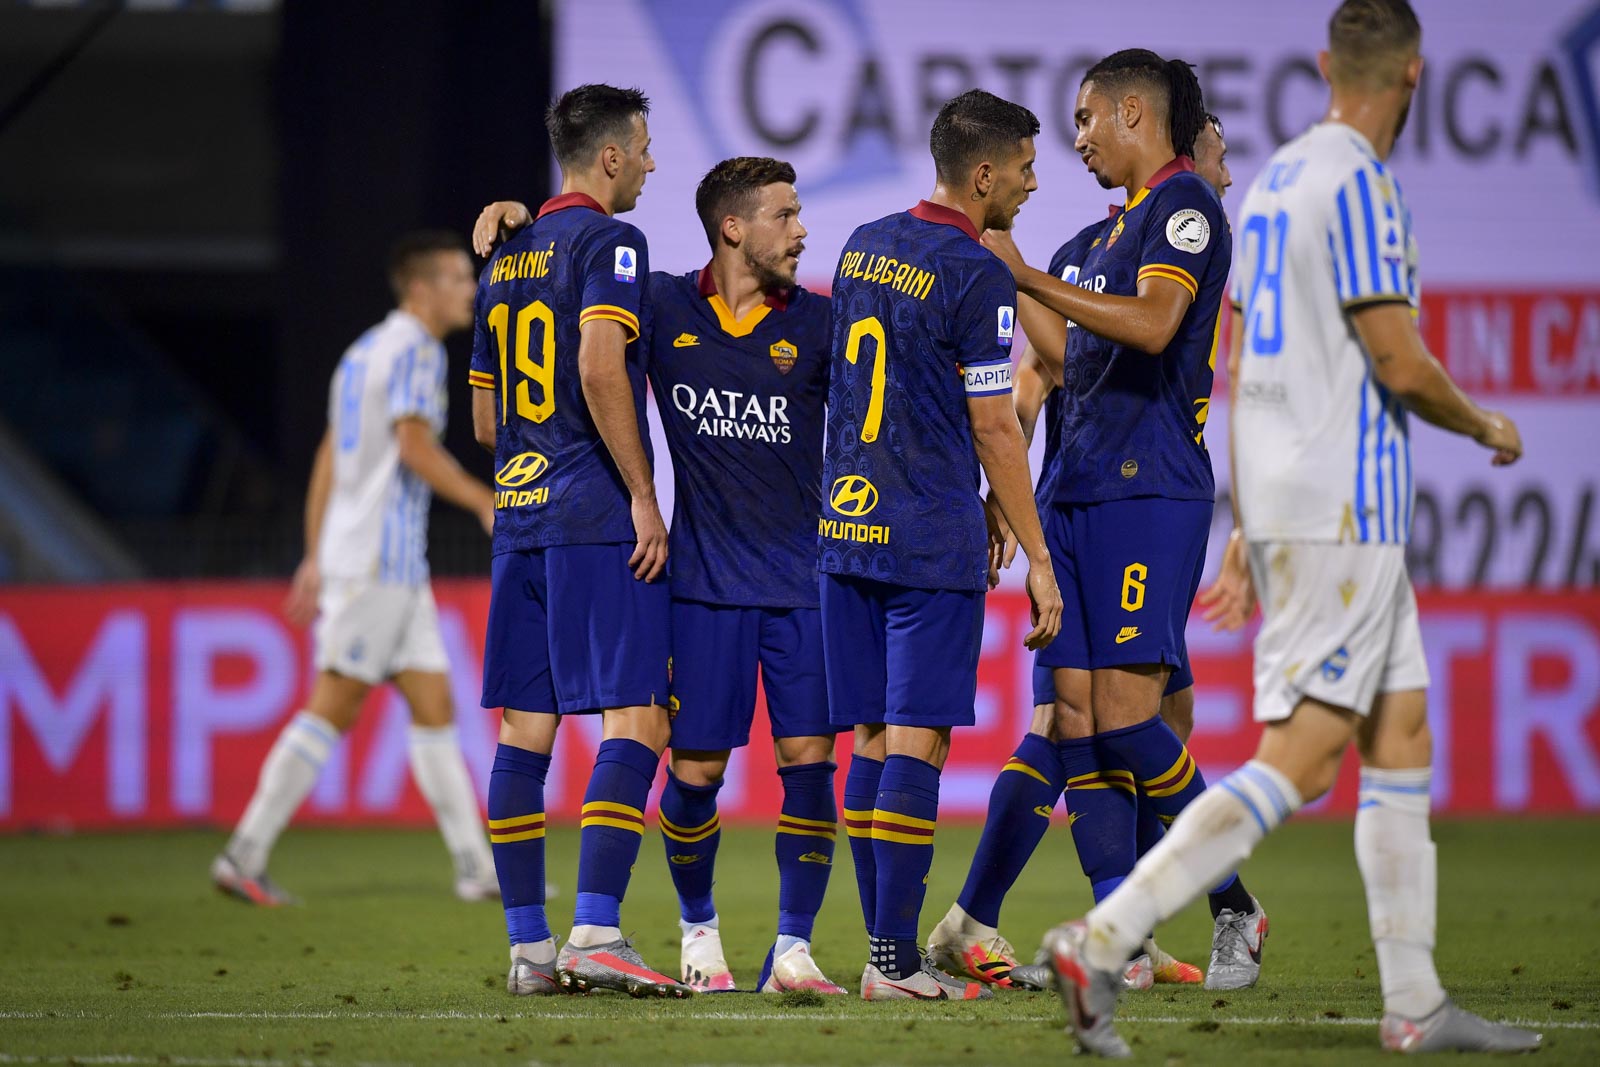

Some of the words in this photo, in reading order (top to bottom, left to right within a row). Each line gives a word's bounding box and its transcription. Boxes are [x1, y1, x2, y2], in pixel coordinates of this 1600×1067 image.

[739, 18, 1579, 162] CARTOECICA
[489, 241, 555, 286] KALINIĆ
[839, 251, 935, 300] PELLEGRINI
[487, 300, 556, 426] 19
[845, 316, 887, 444] 7
[672, 383, 791, 425] QATAR
[697, 417, 792, 444] AIRWAYS
[495, 487, 549, 510] UNDAI
[818, 517, 890, 545] HYUNDAI
[1121, 562, 1148, 612] 6
[1119, 626, 1139, 637] NIKE
